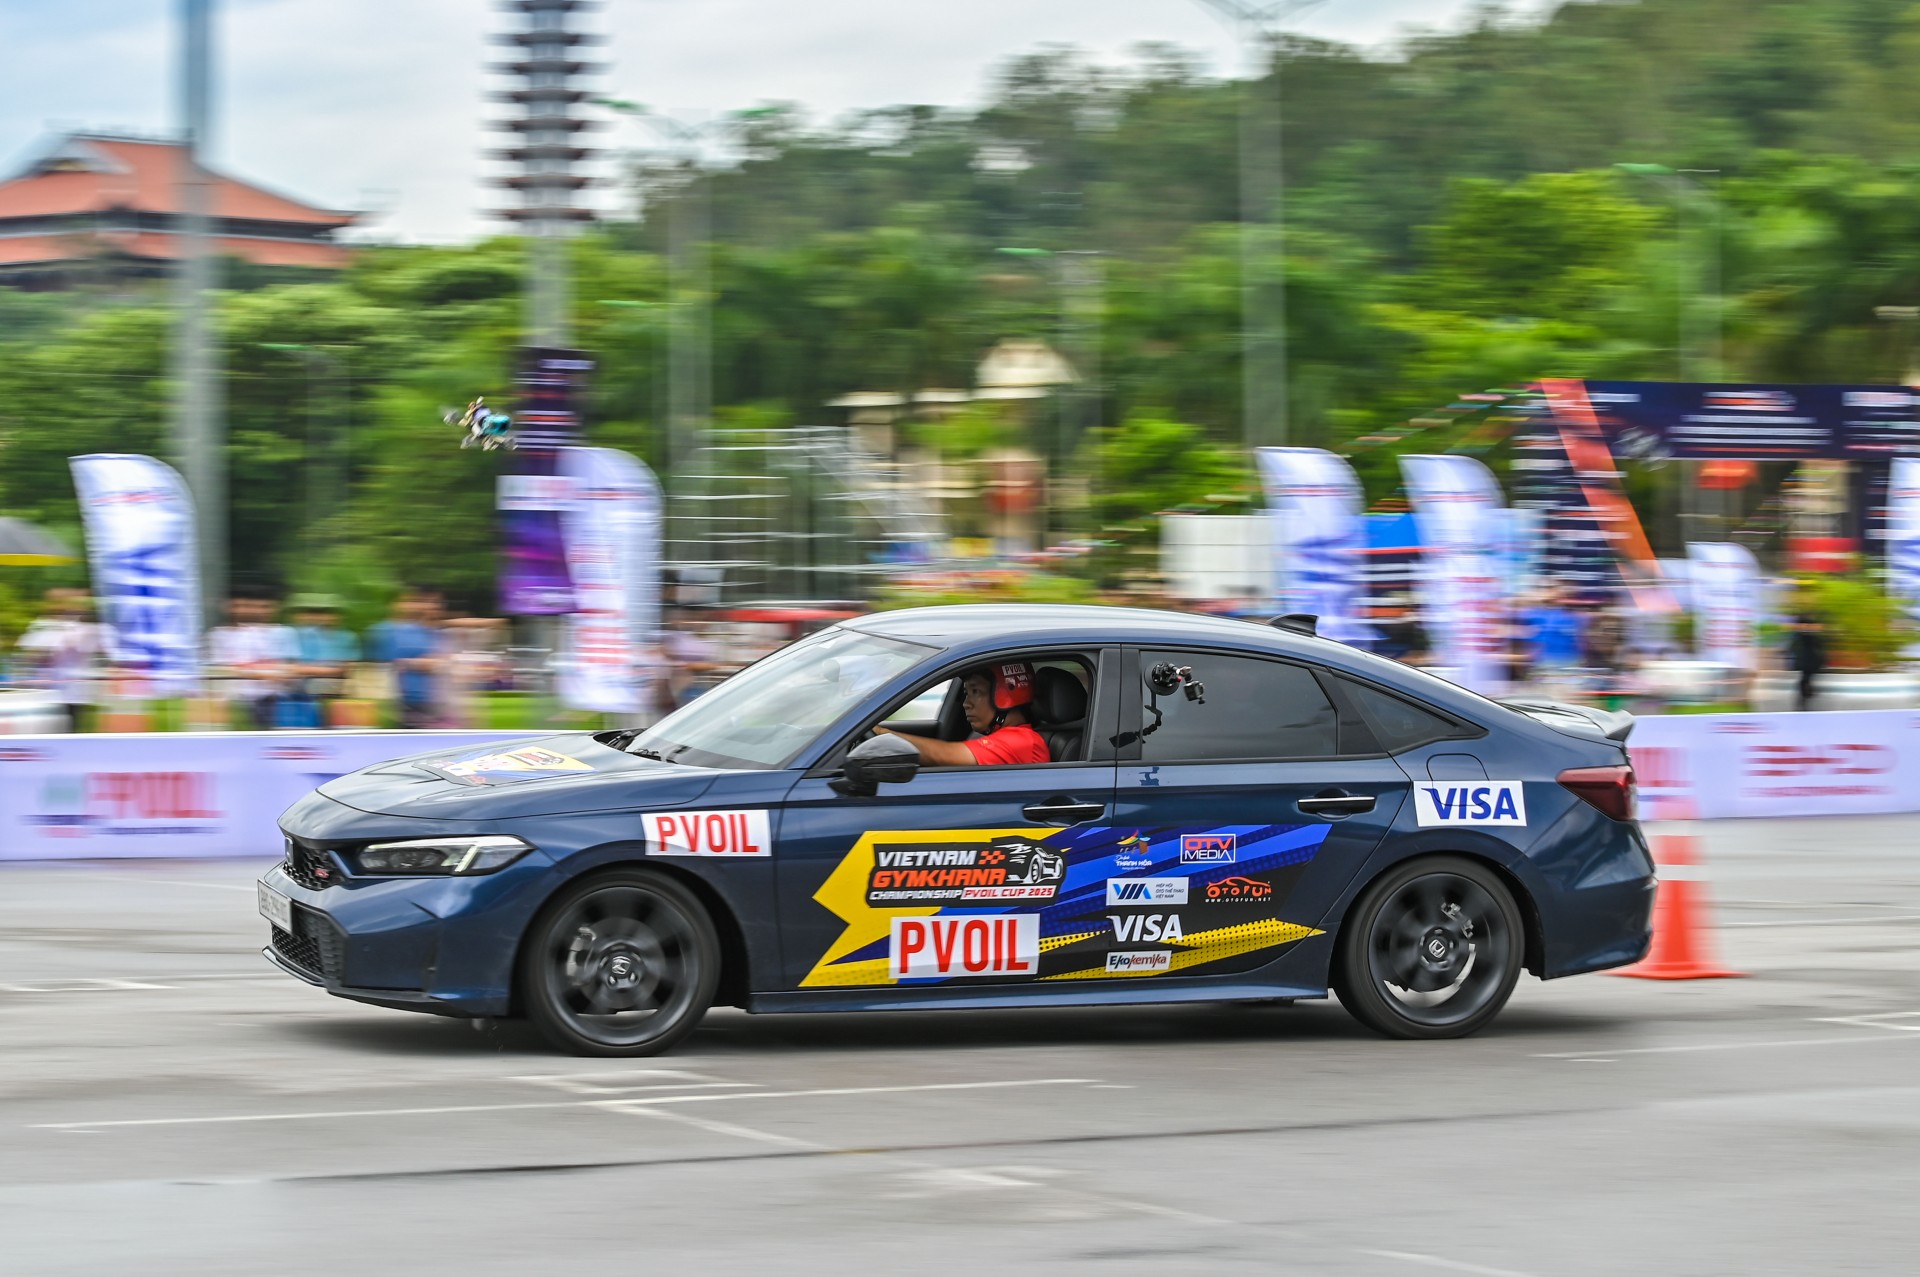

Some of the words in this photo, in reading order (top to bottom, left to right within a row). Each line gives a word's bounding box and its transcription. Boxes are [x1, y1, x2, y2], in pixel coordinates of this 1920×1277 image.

[1421, 787, 1519, 820] VISA
[656, 813, 760, 853] PVOIL
[1184, 837, 1233, 850] OTV
[878, 850, 977, 867] VIETNAM
[1184, 849, 1233, 862] MEDIA
[872, 868, 1007, 888] GYMKHANA
[869, 889, 962, 900] CHAMPIONSHIP
[964, 887, 998, 899] PVOIL
[1001, 887, 1026, 898] CUP
[1028, 887, 1053, 897] 2025
[1106, 914, 1184, 942] VISA
[899, 919, 1030, 974] PVOIL
[1109, 953, 1167, 969] Ekokemika
